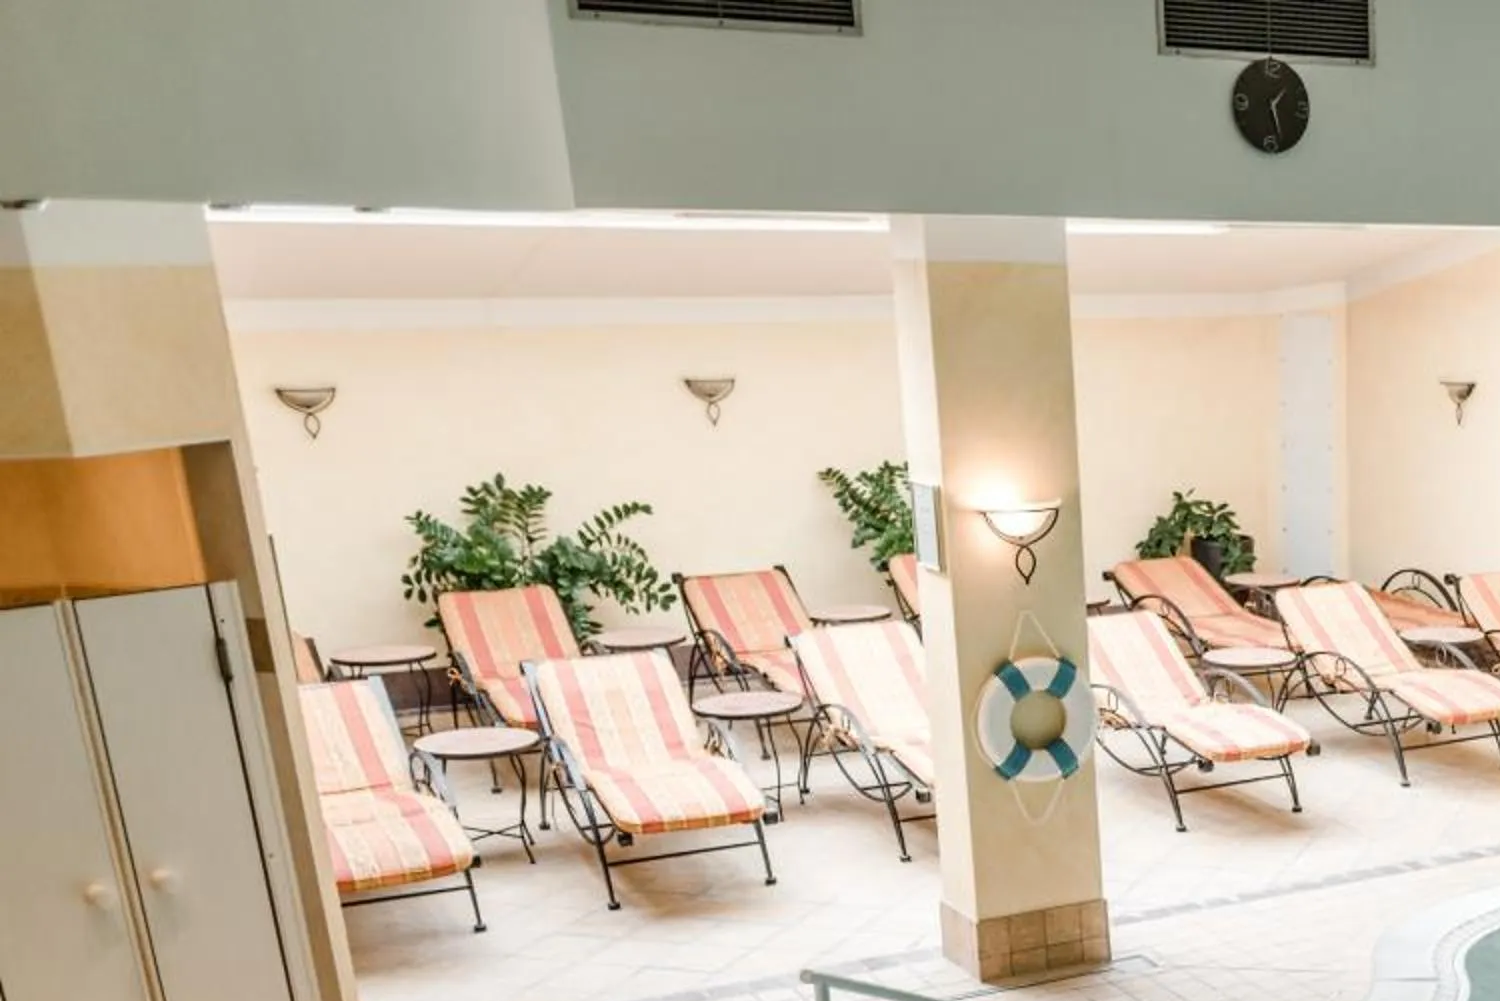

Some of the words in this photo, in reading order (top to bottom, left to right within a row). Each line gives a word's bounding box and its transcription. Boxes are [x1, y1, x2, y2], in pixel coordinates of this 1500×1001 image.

[1265, 60, 1281, 79] 12
[1235, 93, 1249, 111] 9
[1263, 135, 1279, 152] 6
